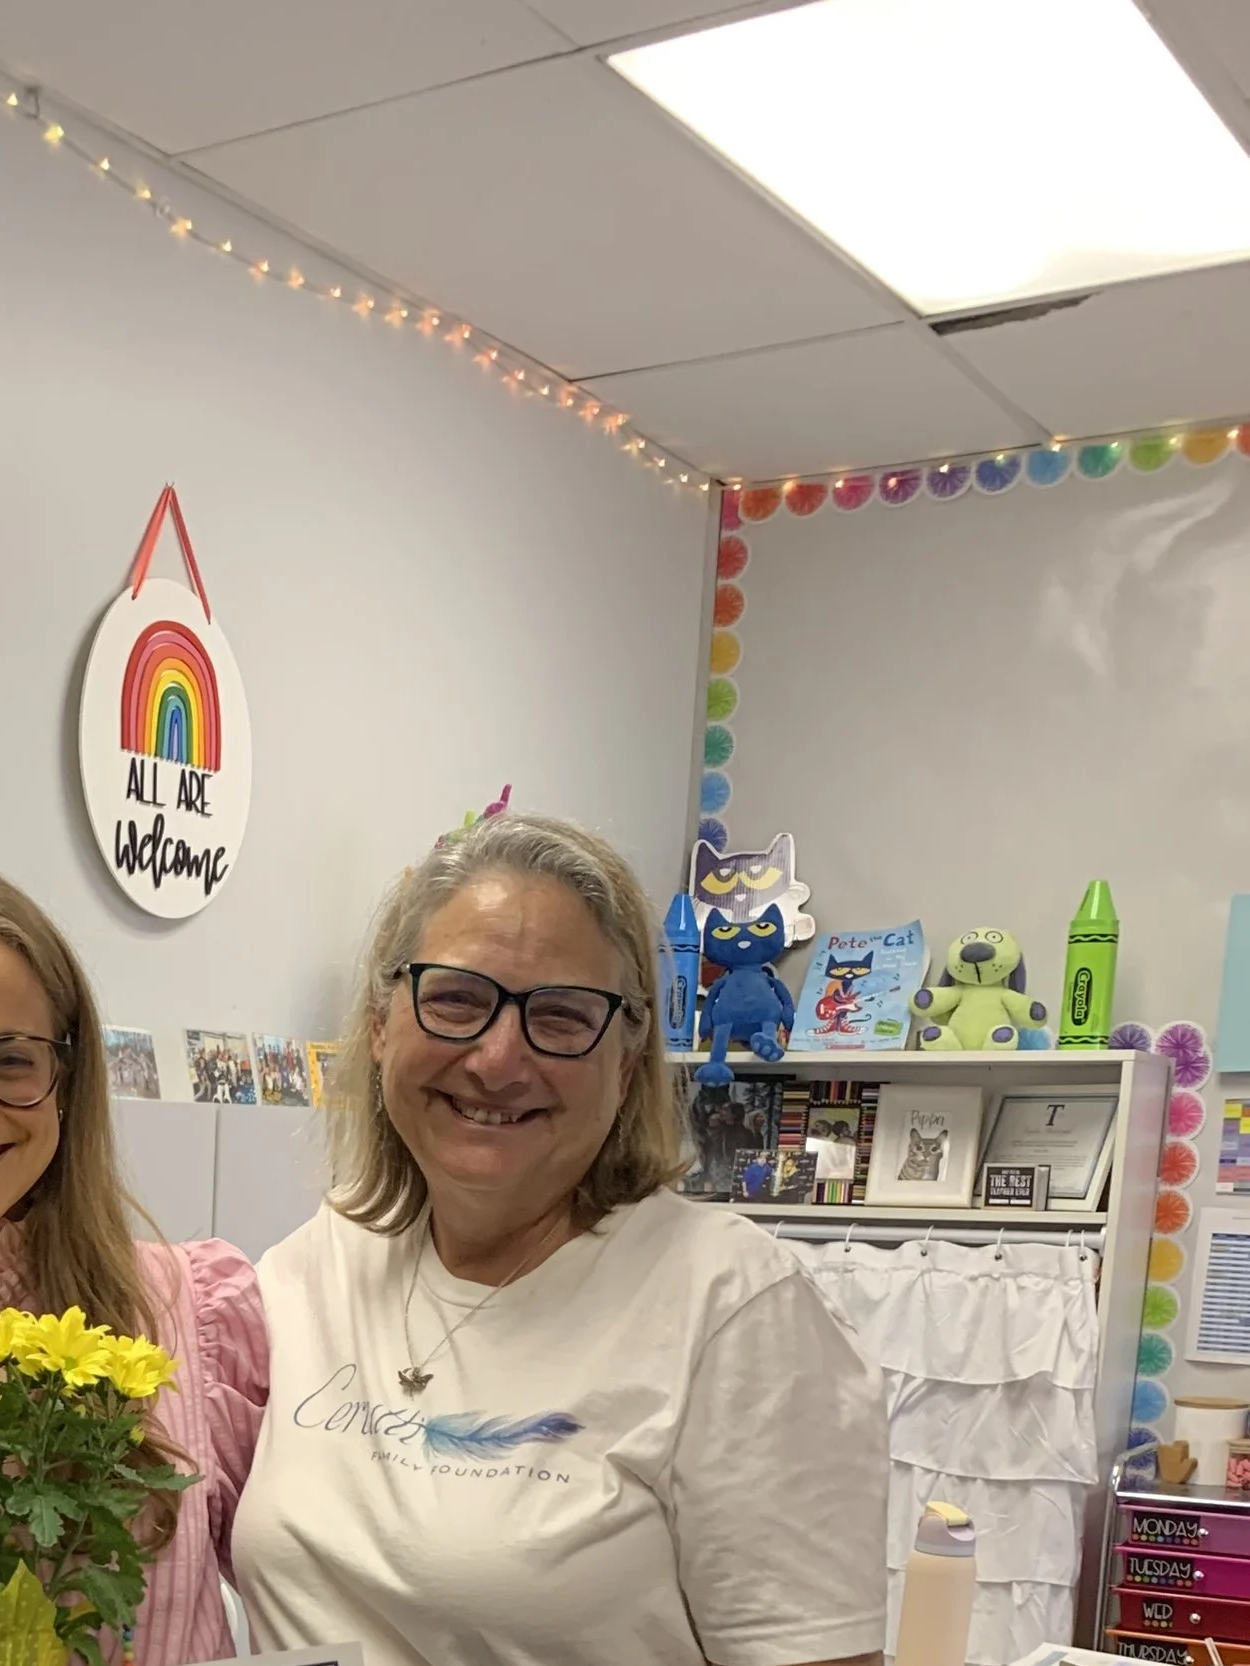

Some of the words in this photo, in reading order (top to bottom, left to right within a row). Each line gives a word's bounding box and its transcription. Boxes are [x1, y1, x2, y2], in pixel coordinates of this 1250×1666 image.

[126, 757, 166, 807] ALL
[177, 768, 214, 818] ARE
[828, 936, 868, 950] Pete
[883, 930, 915, 947] Cat
[1074, 969, 1090, 1021] Crayola
[1045, 1104, 1065, 1127] T
[989, 1174, 1007, 1187] THE
[431, 1464, 571, 1484] FOUNDATION
[1133, 1516, 1199, 1538] MONDAY
[1129, 1557, 1192, 1579] TUESDAY
[1143, 1602, 1174, 1621] WED
[1117, 1640, 1191, 1666] THURSDAY
